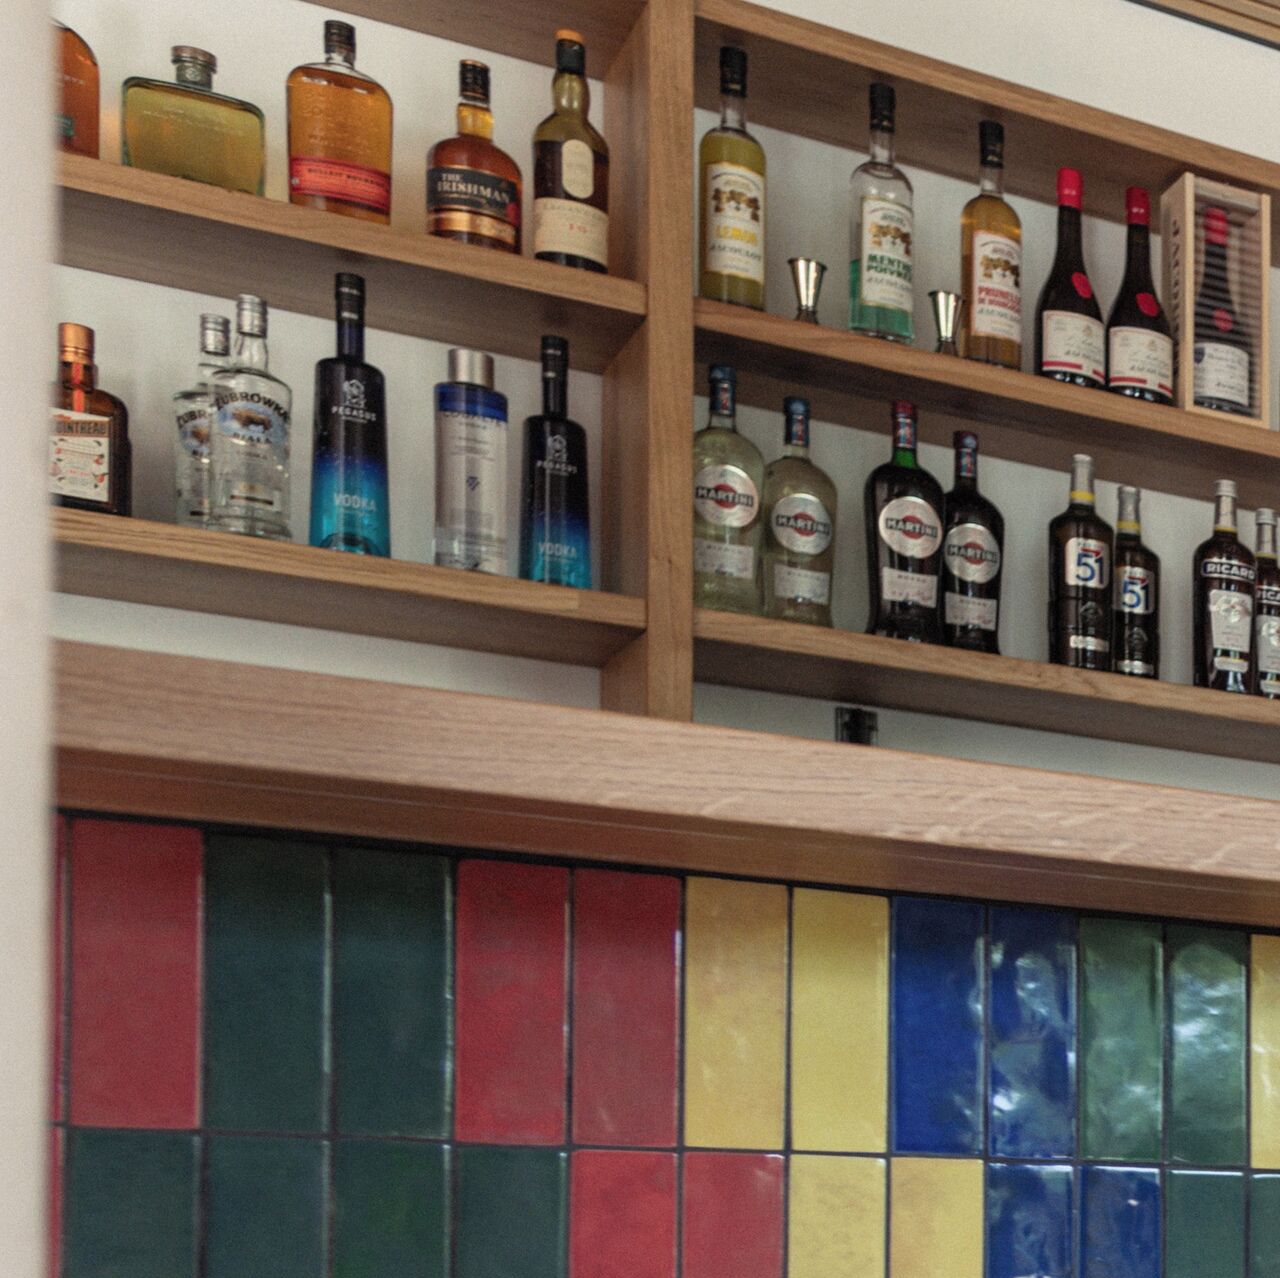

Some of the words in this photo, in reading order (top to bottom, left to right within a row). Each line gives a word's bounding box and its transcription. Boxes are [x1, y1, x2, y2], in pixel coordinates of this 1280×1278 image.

[440, 172, 463, 183] THE
[436, 181, 511, 204] IRISHMAN
[331, 405, 377, 421] PEGASUS
[55, 420, 107, 435] OINTREAU
[334, 492, 377, 511] VODKA
[696, 487, 754, 506] MARTINI
[776, 516, 830, 534] MARTINI
[886, 519, 938, 537] MARTINI
[539, 542, 577, 558] VODKA
[949, 545, 999, 562] MARTINI
[1076, 553, 1104, 585] 51
[1206, 563, 1255, 580] RICARD
[1122, 580, 1149, 611] 51
